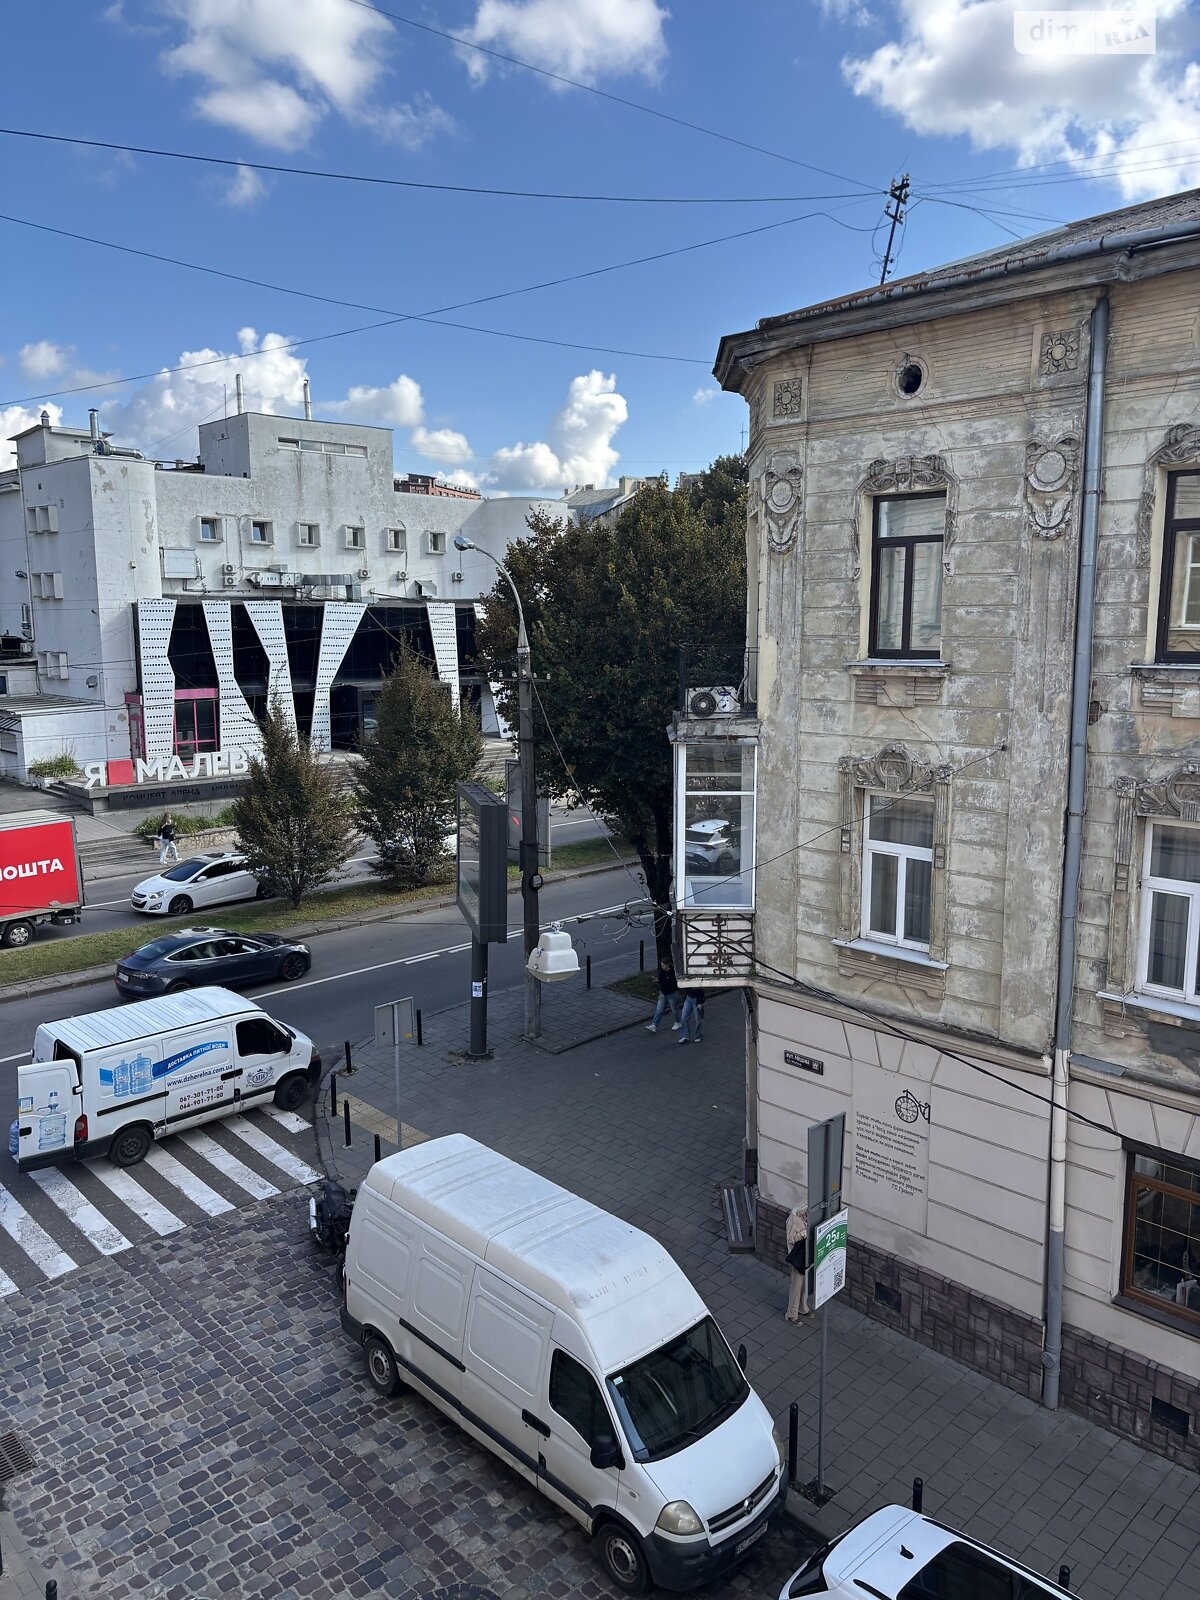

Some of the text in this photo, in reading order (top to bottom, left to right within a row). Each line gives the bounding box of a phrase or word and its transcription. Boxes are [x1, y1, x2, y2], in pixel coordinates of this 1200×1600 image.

[83, 761, 107, 789] Я
[0, 858, 64, 881] ОШТА
[167, 1052, 193, 1069] ДОСТАВКА
[192, 1044, 212, 1056] ПИТНОЇ
[166, 1064, 233, 1088] www.dzherelna.com.ua
[179, 1084, 224, 1103] 067-301-71-00
[179, 1092, 224, 1110] 066-901-71-00
